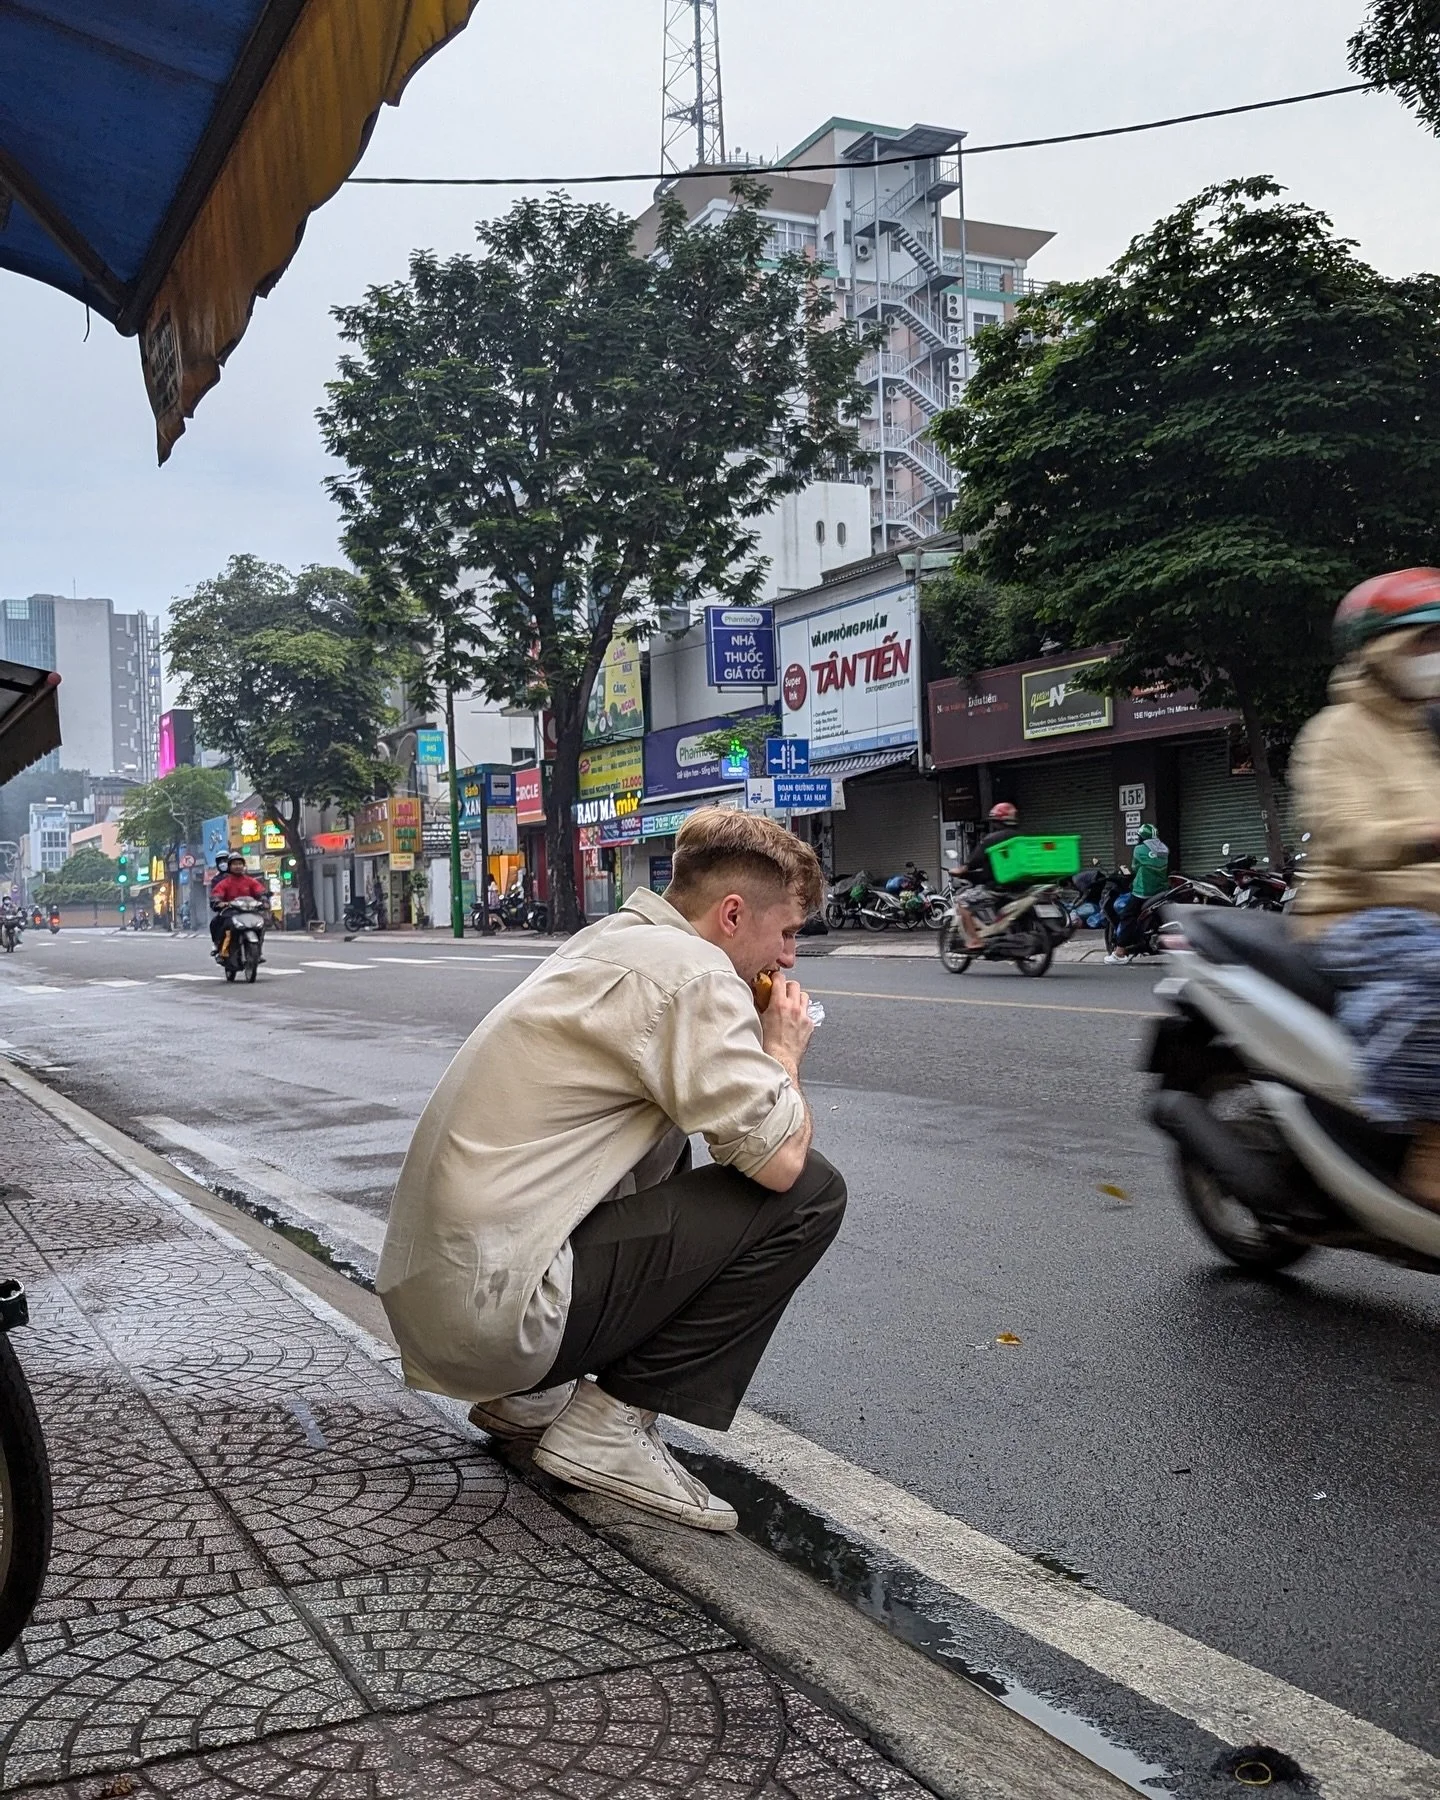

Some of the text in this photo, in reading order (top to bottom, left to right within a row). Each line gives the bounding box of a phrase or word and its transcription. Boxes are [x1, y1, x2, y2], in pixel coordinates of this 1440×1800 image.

[724, 613, 760, 625] Pharmacity
[731, 632, 756, 646] NHÀ
[724, 647, 764, 663] THUỐC
[810, 631, 912, 695] TÂN TIẾN
[724, 664, 767, 680] GIÁ TỐT
[785, 677, 801, 688] Super
[621, 775, 642, 789] 12.000
[777, 784, 793, 792] ĐOẠN
[795, 782, 815, 792] ĐƯỜNG
[516, 783, 539, 801] CIRCLE
[803, 793, 813, 801] TAI
[814, 793, 827, 803] NẠN
[1121, 788, 1144, 806] 15E
[577, 791, 639, 825] RAU MÁ mix
